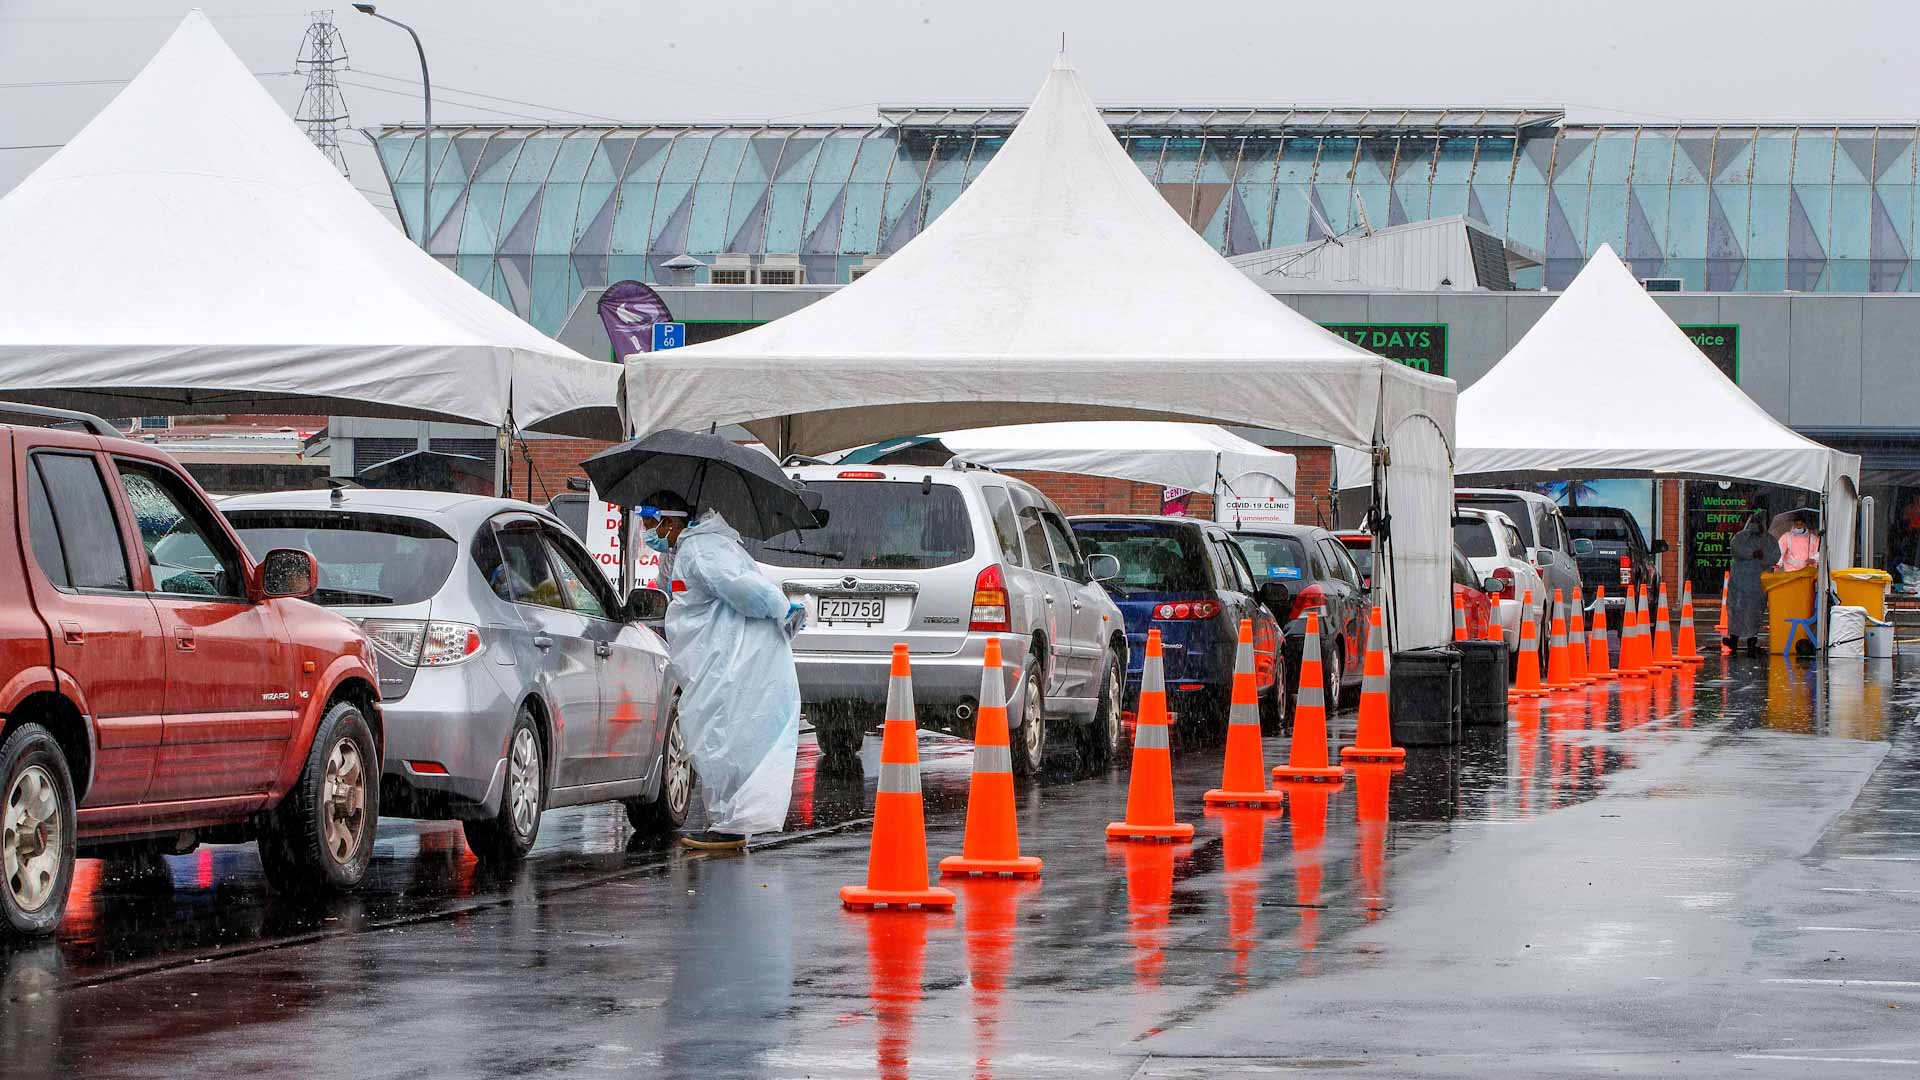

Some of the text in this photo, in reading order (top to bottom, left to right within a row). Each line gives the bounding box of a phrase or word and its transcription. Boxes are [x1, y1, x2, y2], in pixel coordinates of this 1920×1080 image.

[664, 325, 674, 336] P
[663, 338, 675, 347] 60
[1354, 331, 1367, 346] 7
[1373, 331, 1431, 348] DAYS
[1703, 496, 1747, 506] Welcome
[1706, 514, 1741, 523] ENTRY
[1696, 531, 1725, 540] OPEN
[1696, 541, 1722, 551] 7am
[1697, 559, 1713, 567] Ph.
[820, 601, 882, 617] FZD750
